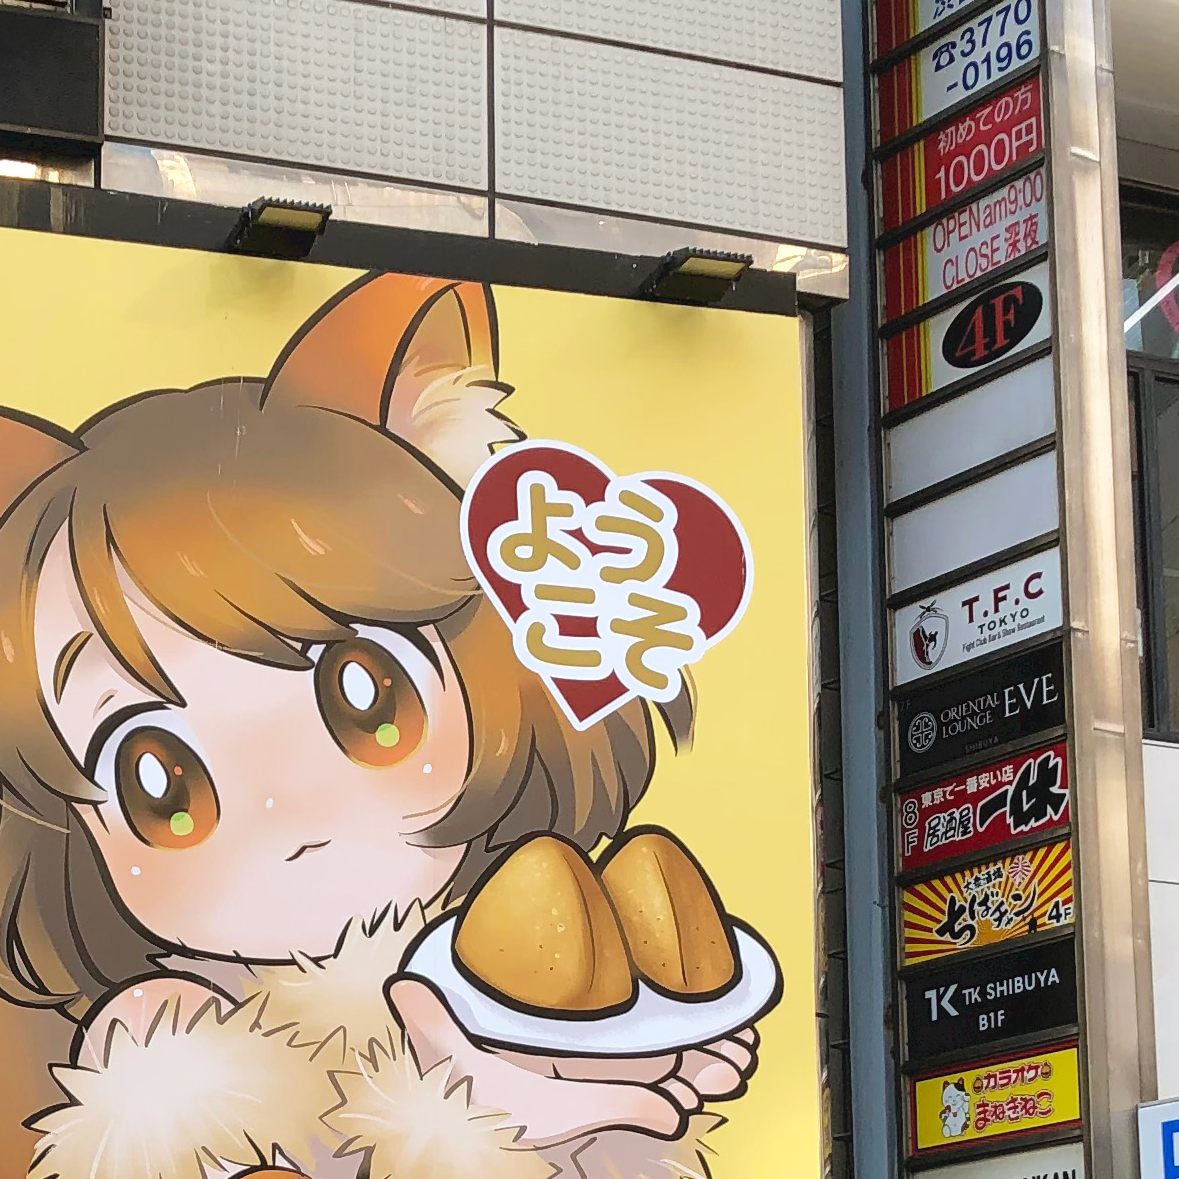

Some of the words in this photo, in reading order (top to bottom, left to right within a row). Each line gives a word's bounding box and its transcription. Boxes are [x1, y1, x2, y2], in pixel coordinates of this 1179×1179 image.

[959, 0, 1032, 58] 3770
[937, 84, 1033, 156] 初めての方
[935, 116, 1037, 200] 1000円
[955, 286, 1026, 362] 4F
[961, 571, 1045, 624] T.F.C
[978, 607, 1029, 635] TOKYO
[940, 692, 1001, 723] ORIENTAL
[1004, 672, 1059, 718] EVE
[942, 710, 993, 739] LOUNGE
[964, 734, 1000, 754] SHIBUYA
[921, 764, 1014, 809] 東京で一番安い店
[923, 803, 974, 852] 居酒屋
[1047, 898, 1072, 925] 4F
[962, 985, 982, 1006] TK
[986, 967, 1060, 1000] SHIBUYA
[978, 1009, 1005, 1031] B1F
[982, 1062, 1041, 1092] カラオケ
[973, 1090, 1054, 1133] まねきねこ
